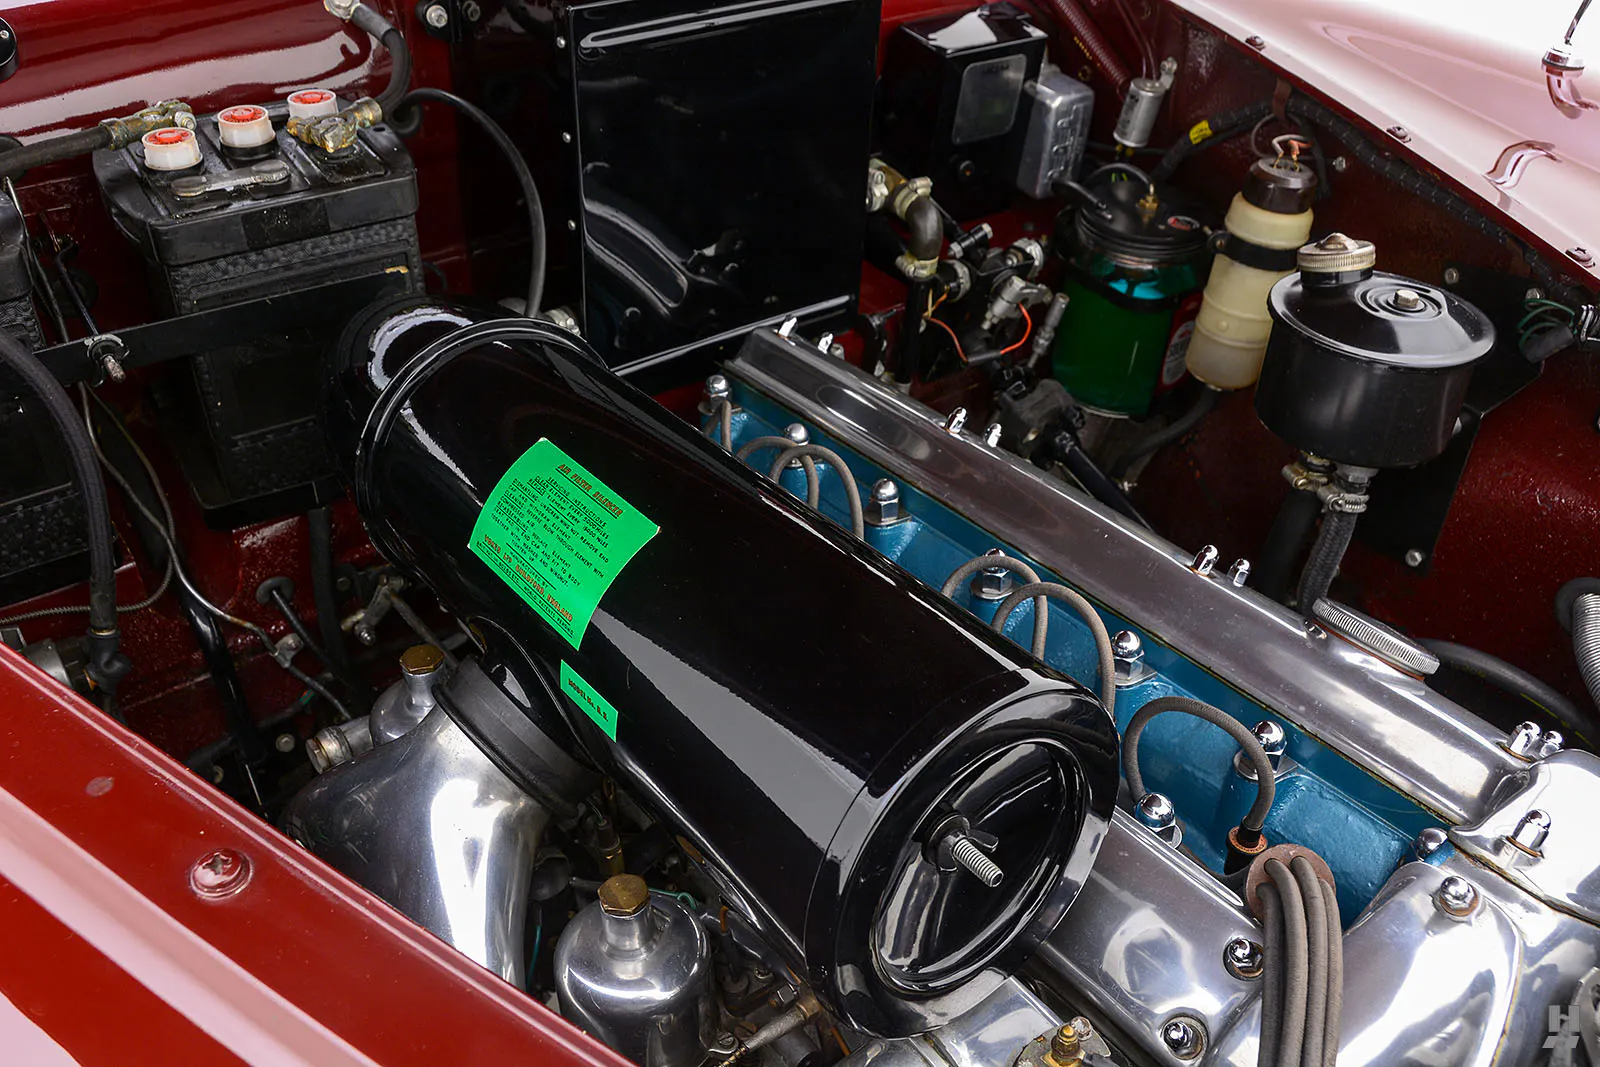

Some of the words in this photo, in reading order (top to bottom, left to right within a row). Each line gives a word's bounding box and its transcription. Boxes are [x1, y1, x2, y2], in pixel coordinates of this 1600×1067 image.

[500, 496, 524, 518] COMPRESSED
[528, 478, 546, 494] REPLACE
[547, 495, 566, 511] ELEMENT
[567, 512, 580, 524] EVERY
[535, 475, 549, 488] CLEAN
[549, 488, 569, 505] ELEMENT
[569, 505, 583, 517] EVERY
[548, 477, 570, 496] SERVICING
[574, 499, 607, 527] INSTRUCTIONS
[558, 464, 571, 475] AIR
[571, 473, 592, 492] FILTER
[592, 491, 623, 517] SILENCER
[529, 503, 550, 522] WITHDRAW
[541, 550, 551, 560] AND
[568, 574, 580, 586] BODY
[552, 550, 571, 568] ELEMENT
[556, 534, 574, 552] THROUGH
[574, 552, 592, 568] ELEMENT
[593, 568, 604, 578] WITH
[580, 536, 598, 553] REMOVE
[599, 553, 609, 563] END
